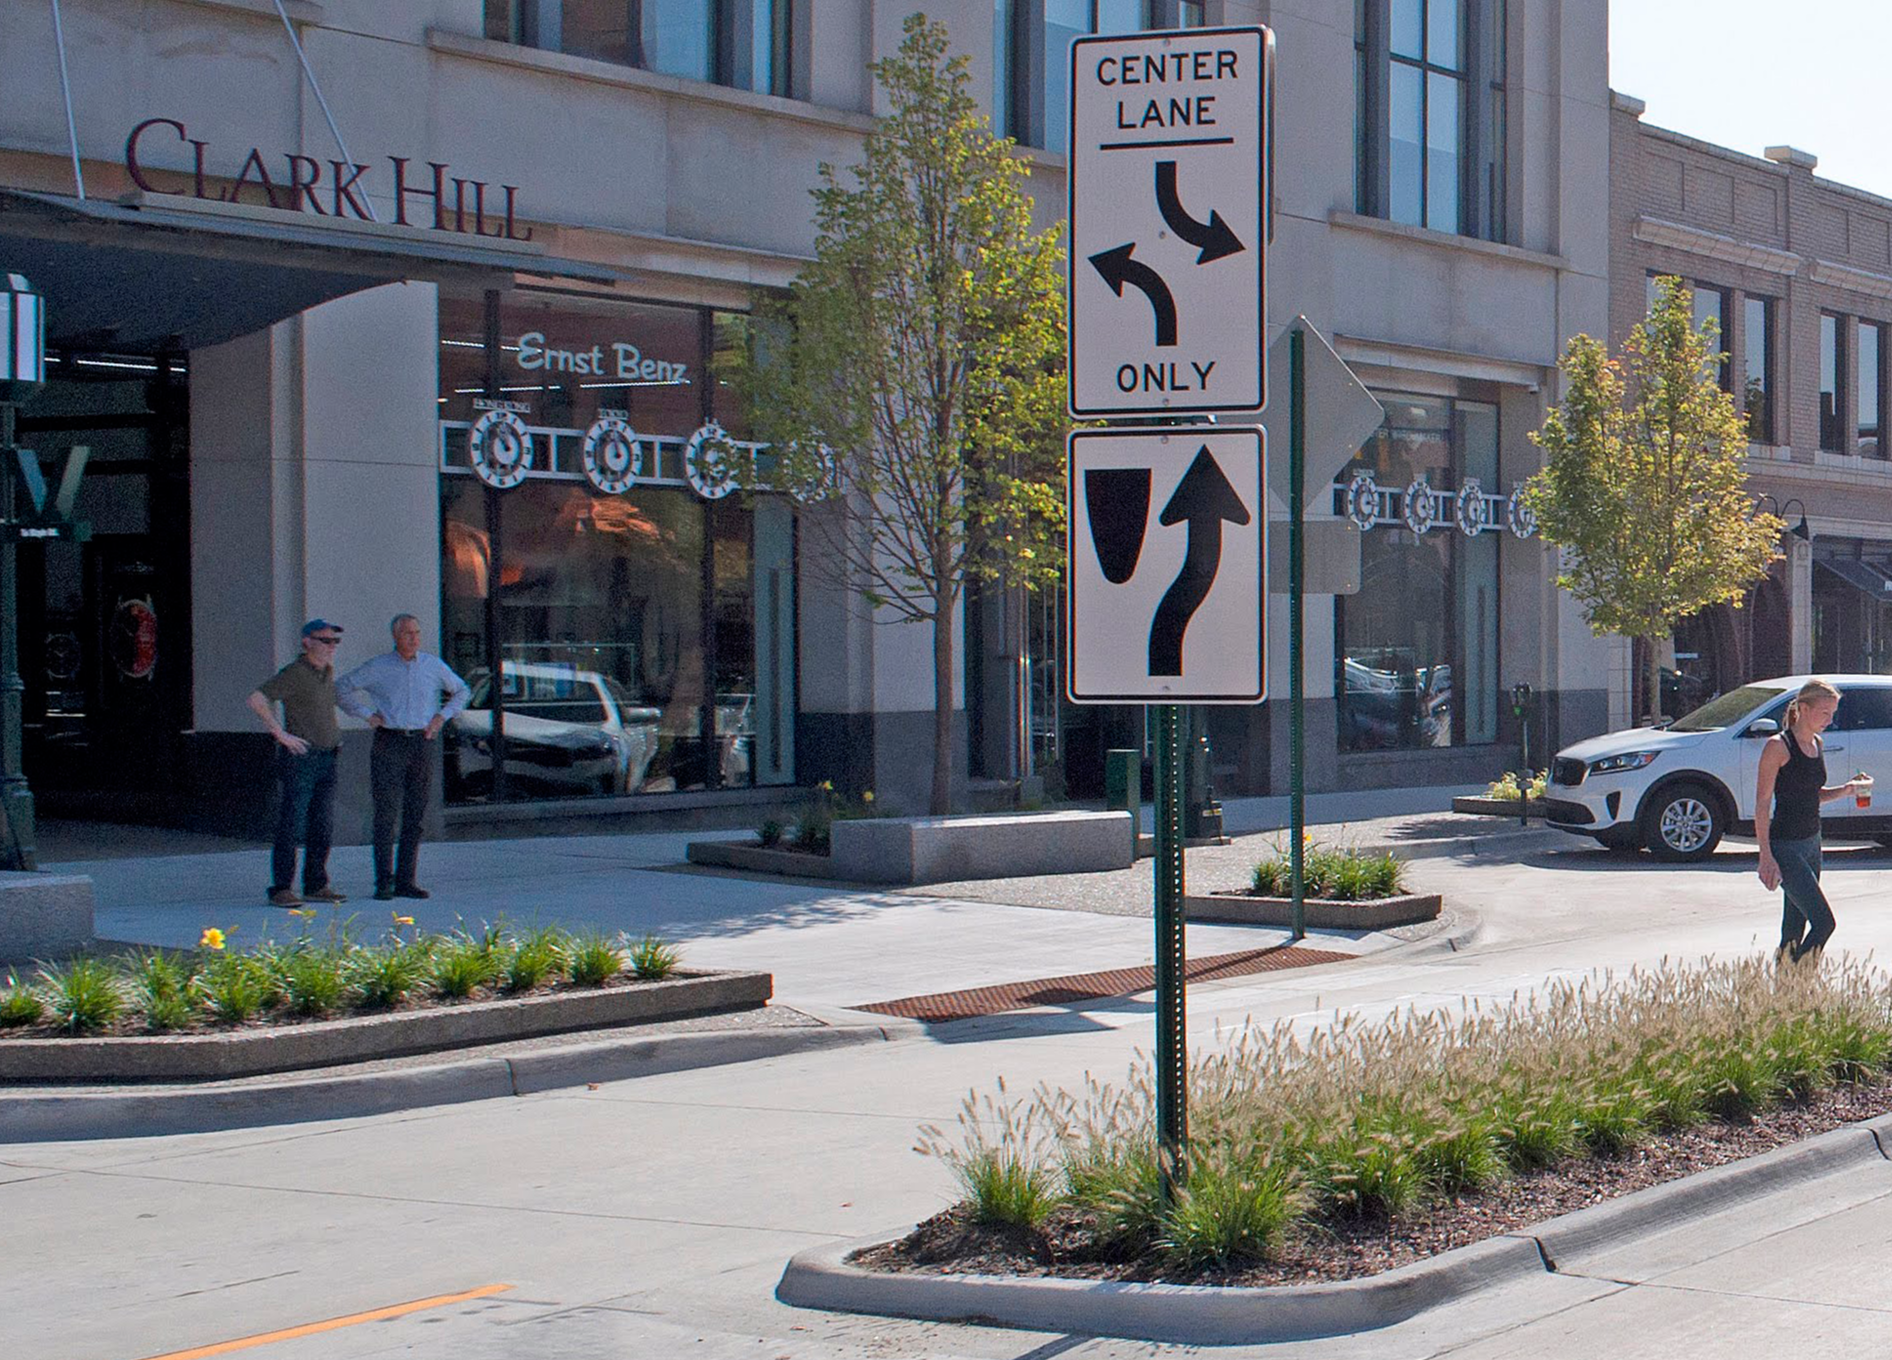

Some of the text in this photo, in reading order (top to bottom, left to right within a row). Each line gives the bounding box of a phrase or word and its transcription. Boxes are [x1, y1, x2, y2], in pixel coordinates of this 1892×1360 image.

[1096, 49, 1238, 86] CENTER
[1117, 96, 1216, 129] LANE
[125, 117, 533, 241] CLARK HILL
[517, 331, 688, 383] Ernst Benz
[1116, 360, 1217, 393] ONLY
